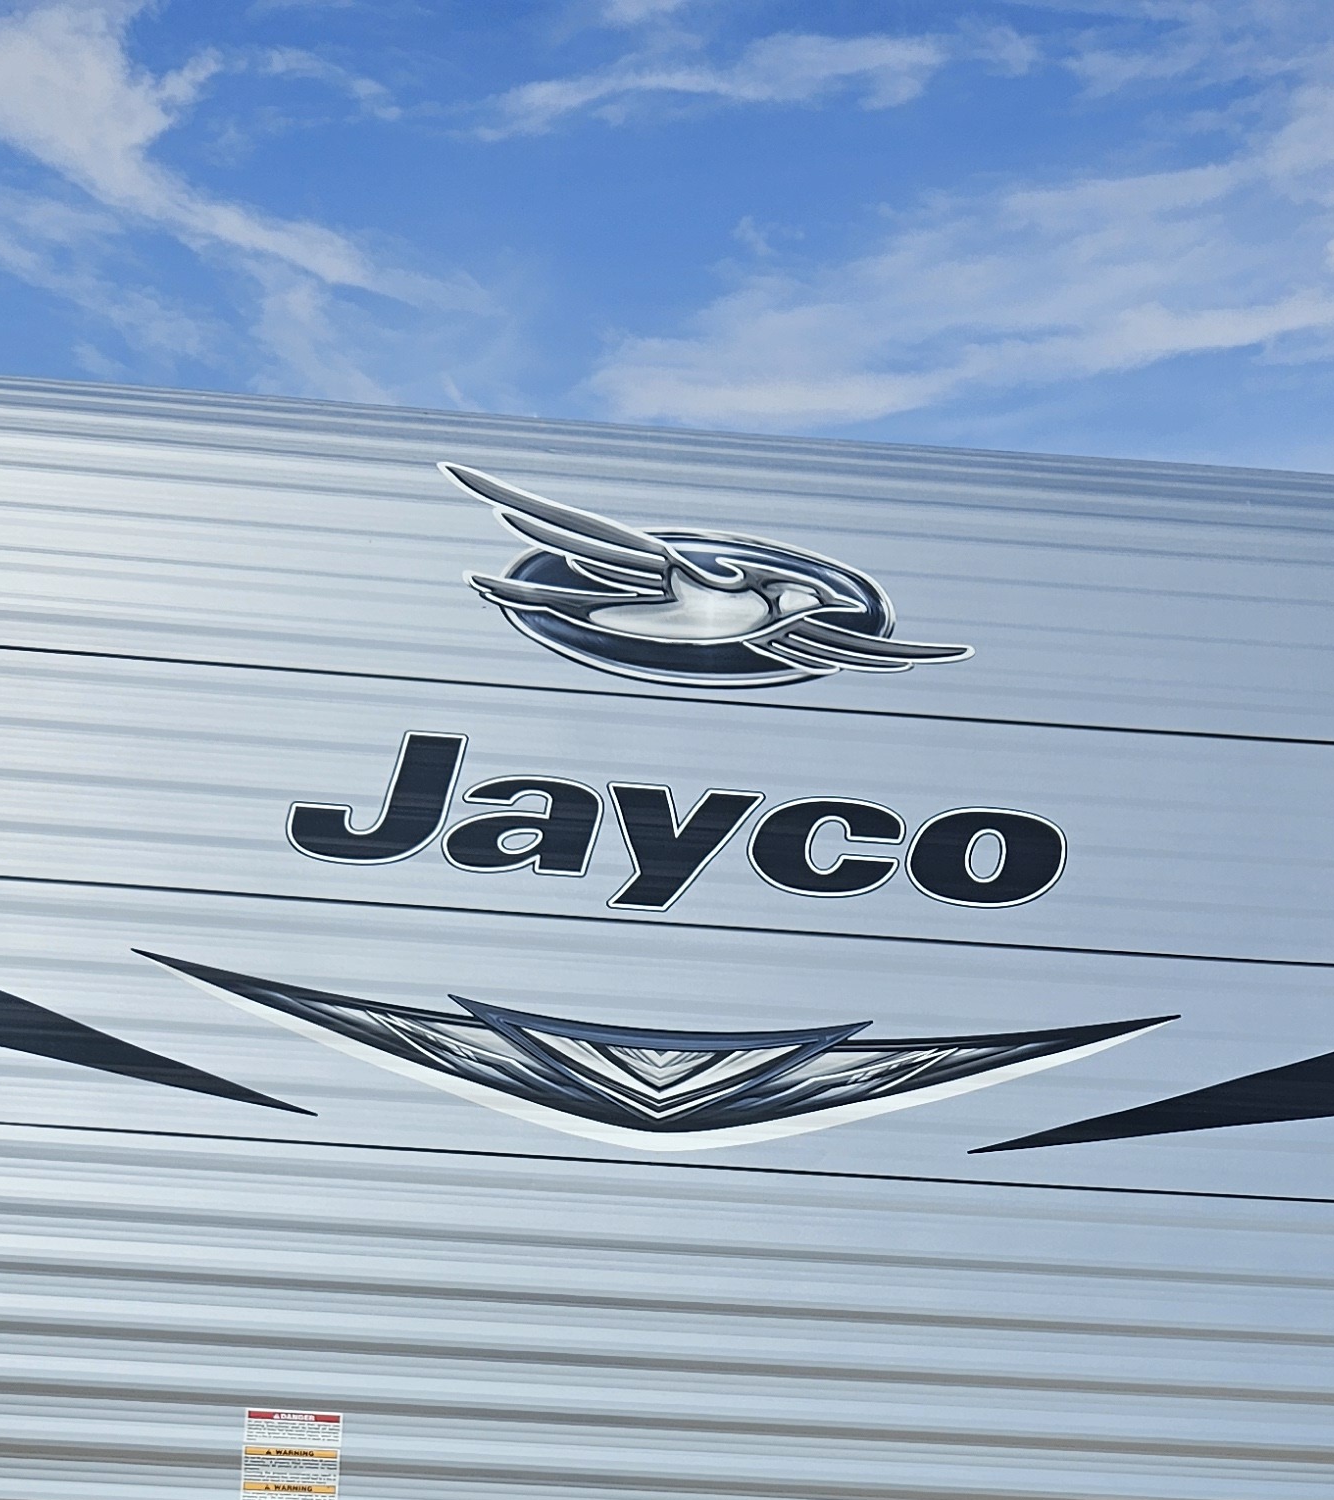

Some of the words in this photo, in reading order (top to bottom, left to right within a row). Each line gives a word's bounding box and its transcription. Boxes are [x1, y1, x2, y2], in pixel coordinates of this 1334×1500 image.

[284, 729, 1069, 913] Jayco
[280, 1413, 316, 1422] DANGER
[275, 1449, 315, 1457] WARNING
[274, 1484, 313, 1492] WARNING
